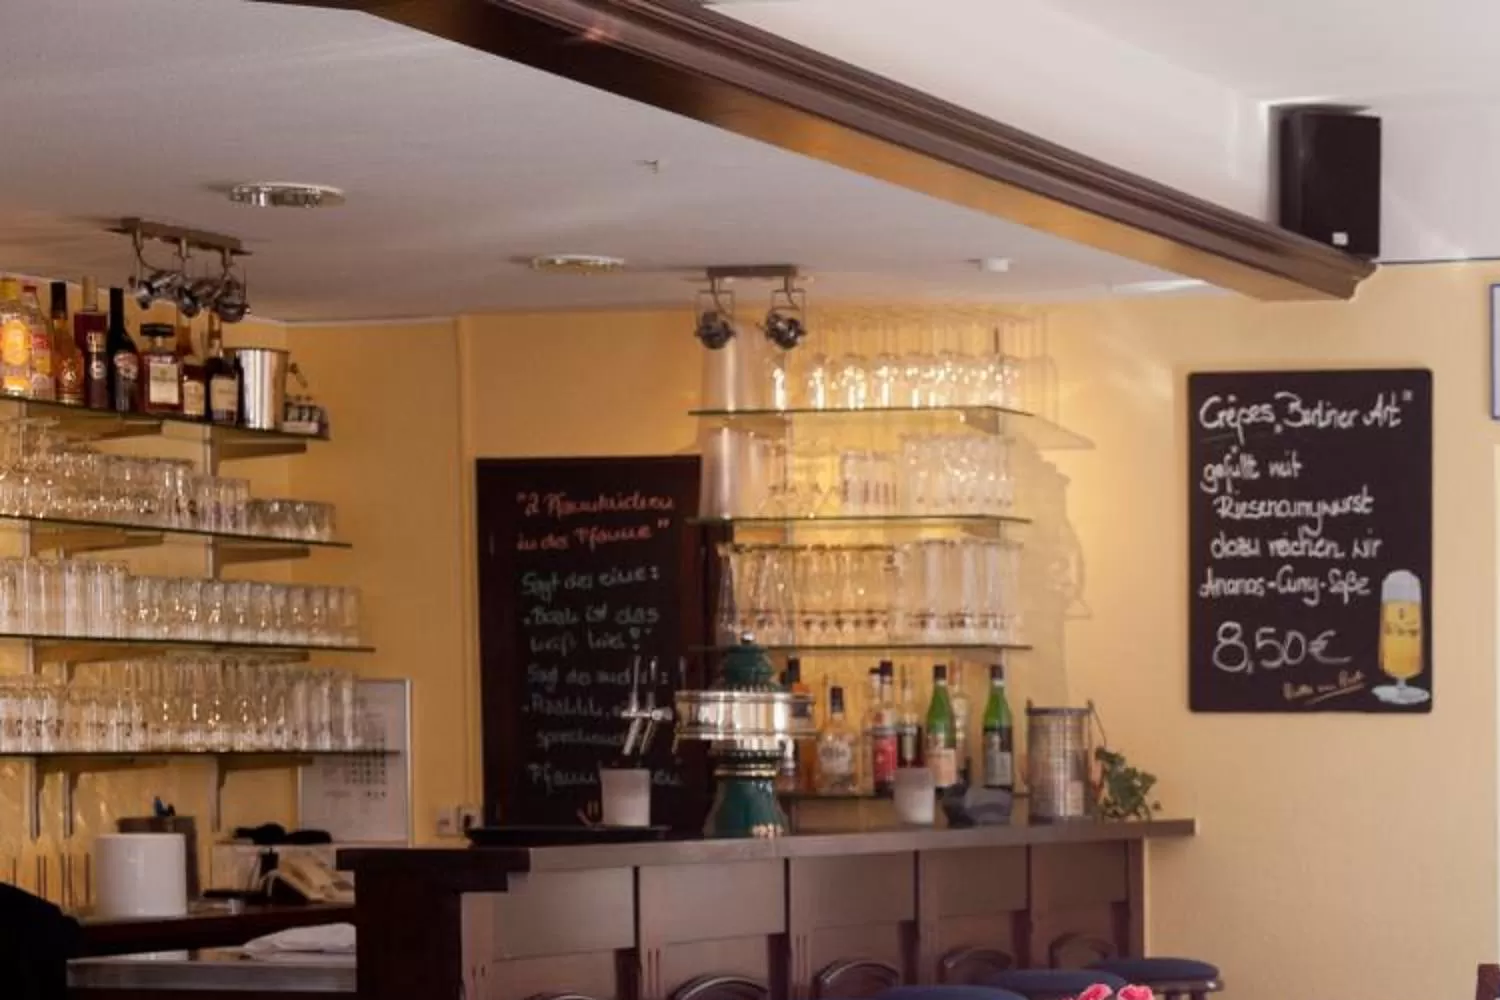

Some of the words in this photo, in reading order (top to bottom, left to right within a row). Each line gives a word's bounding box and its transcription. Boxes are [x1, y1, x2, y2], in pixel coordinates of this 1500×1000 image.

[1268, 449, 1303, 479] mit
[1210, 530, 1262, 559] dazu
[1352, 527, 1383, 558] wir
[614, 602, 660, 625] das
